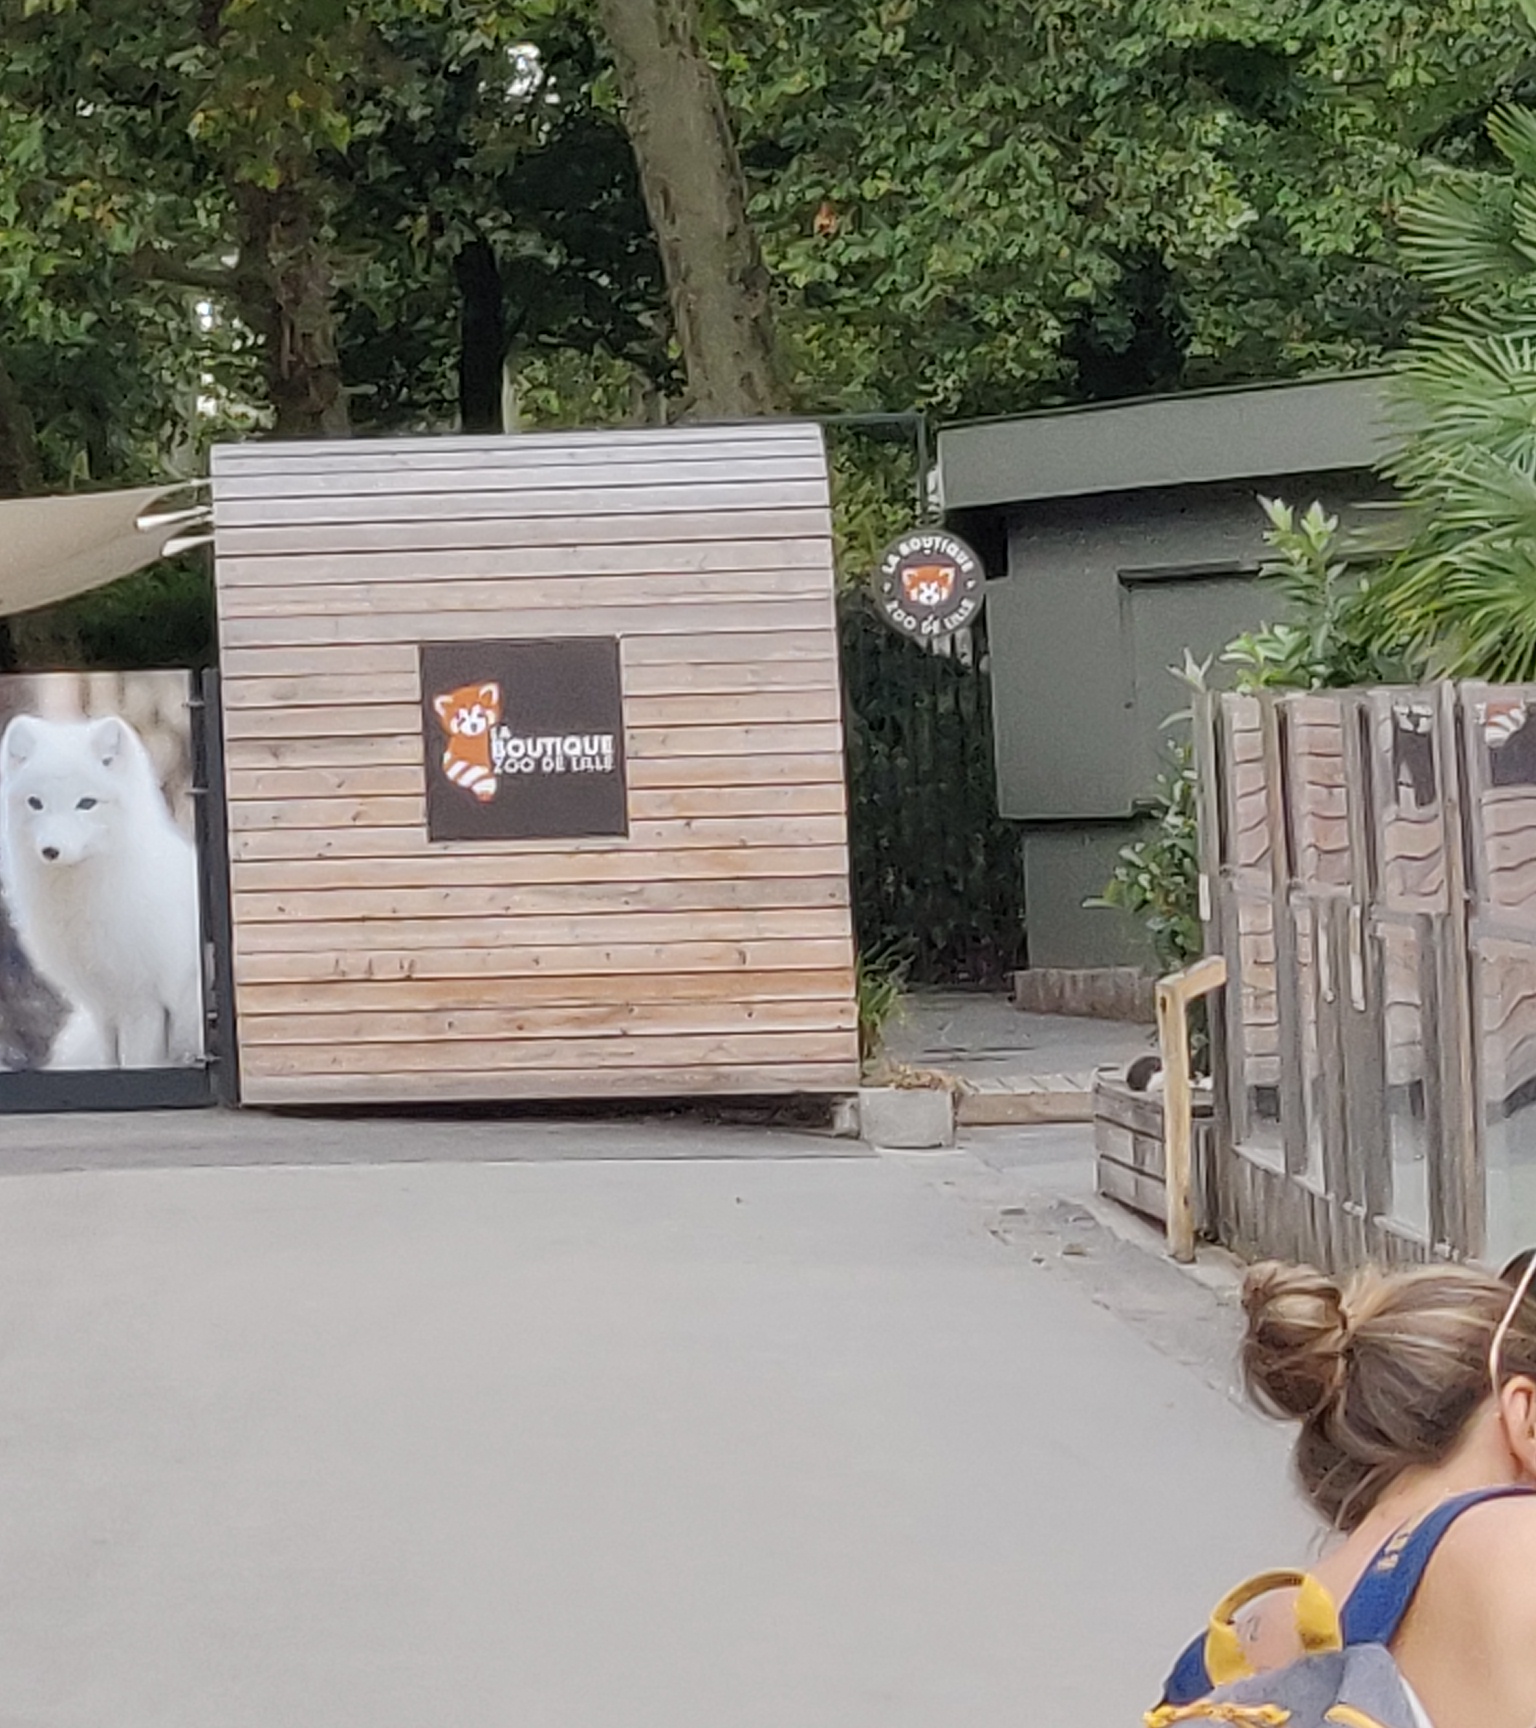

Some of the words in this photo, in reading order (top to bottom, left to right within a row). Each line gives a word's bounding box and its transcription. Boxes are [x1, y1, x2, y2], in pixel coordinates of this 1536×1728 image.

[882, 554, 901, 574] LA
[899, 536, 974, 573] BOUTIQUE
[886, 599, 916, 630] ZOO
[921, 617, 941, 634] DE
[943, 598, 975, 630] LILLE
[490, 725, 512, 740] LA
[492, 735, 614, 760] BOUTIQUE
[493, 756, 535, 774] ZOO
[542, 756, 566, 773] DE
[571, 755, 615, 773] LILLE
